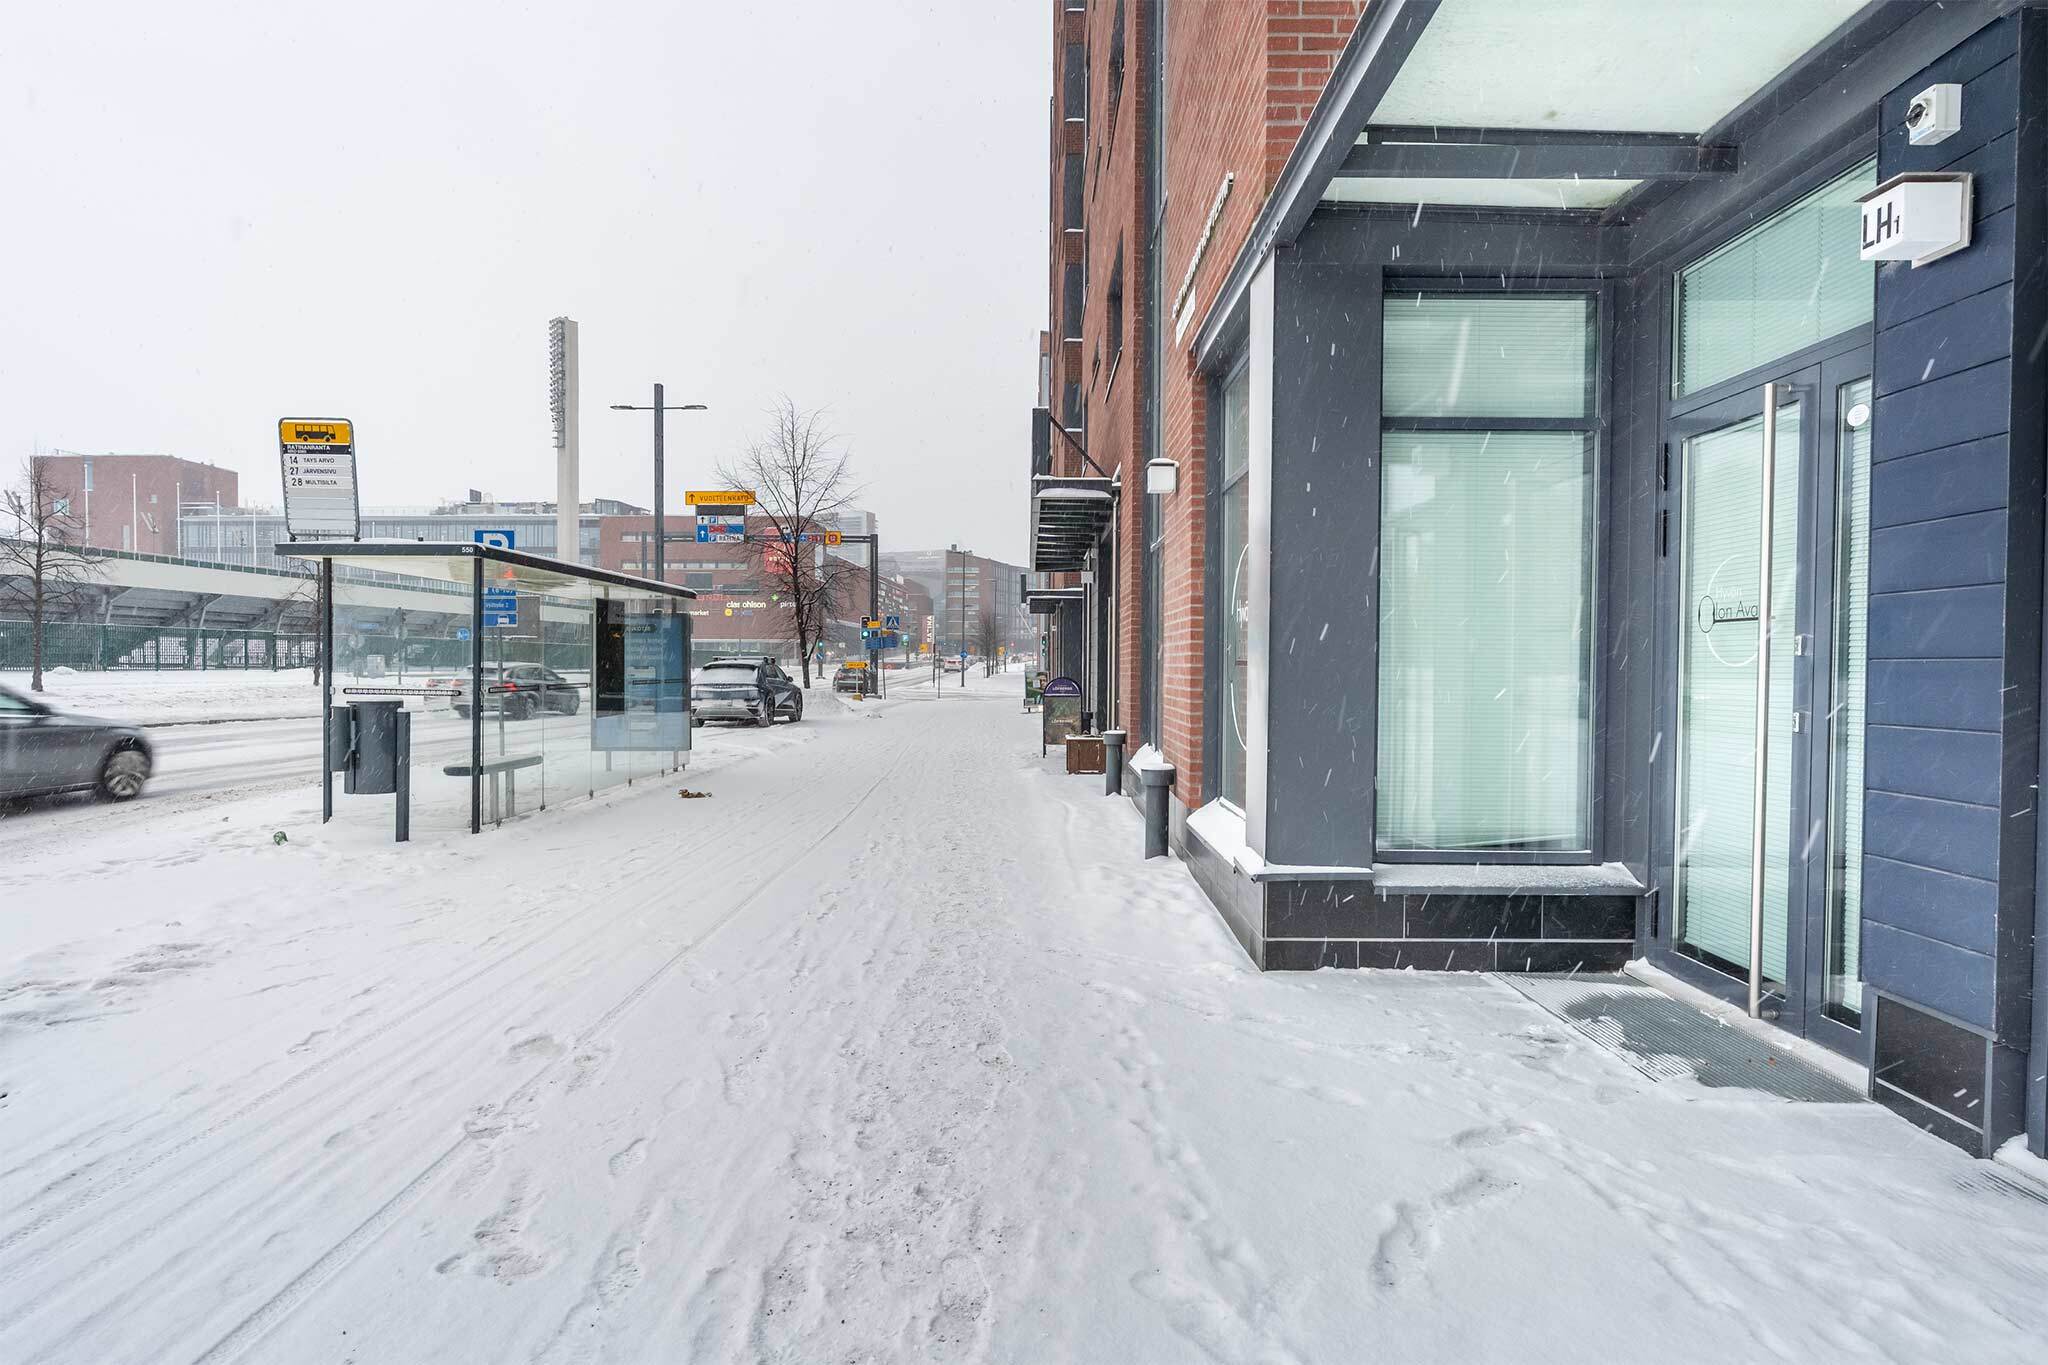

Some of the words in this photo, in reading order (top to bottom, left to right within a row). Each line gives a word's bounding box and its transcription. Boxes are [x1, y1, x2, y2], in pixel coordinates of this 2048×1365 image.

[289, 456, 298, 464] 14
[289, 467, 298, 475] 27
[291, 478, 303, 486] 28
[1735, 600, 1759, 618] Ava
[926, 615, 935, 643] RATINA
